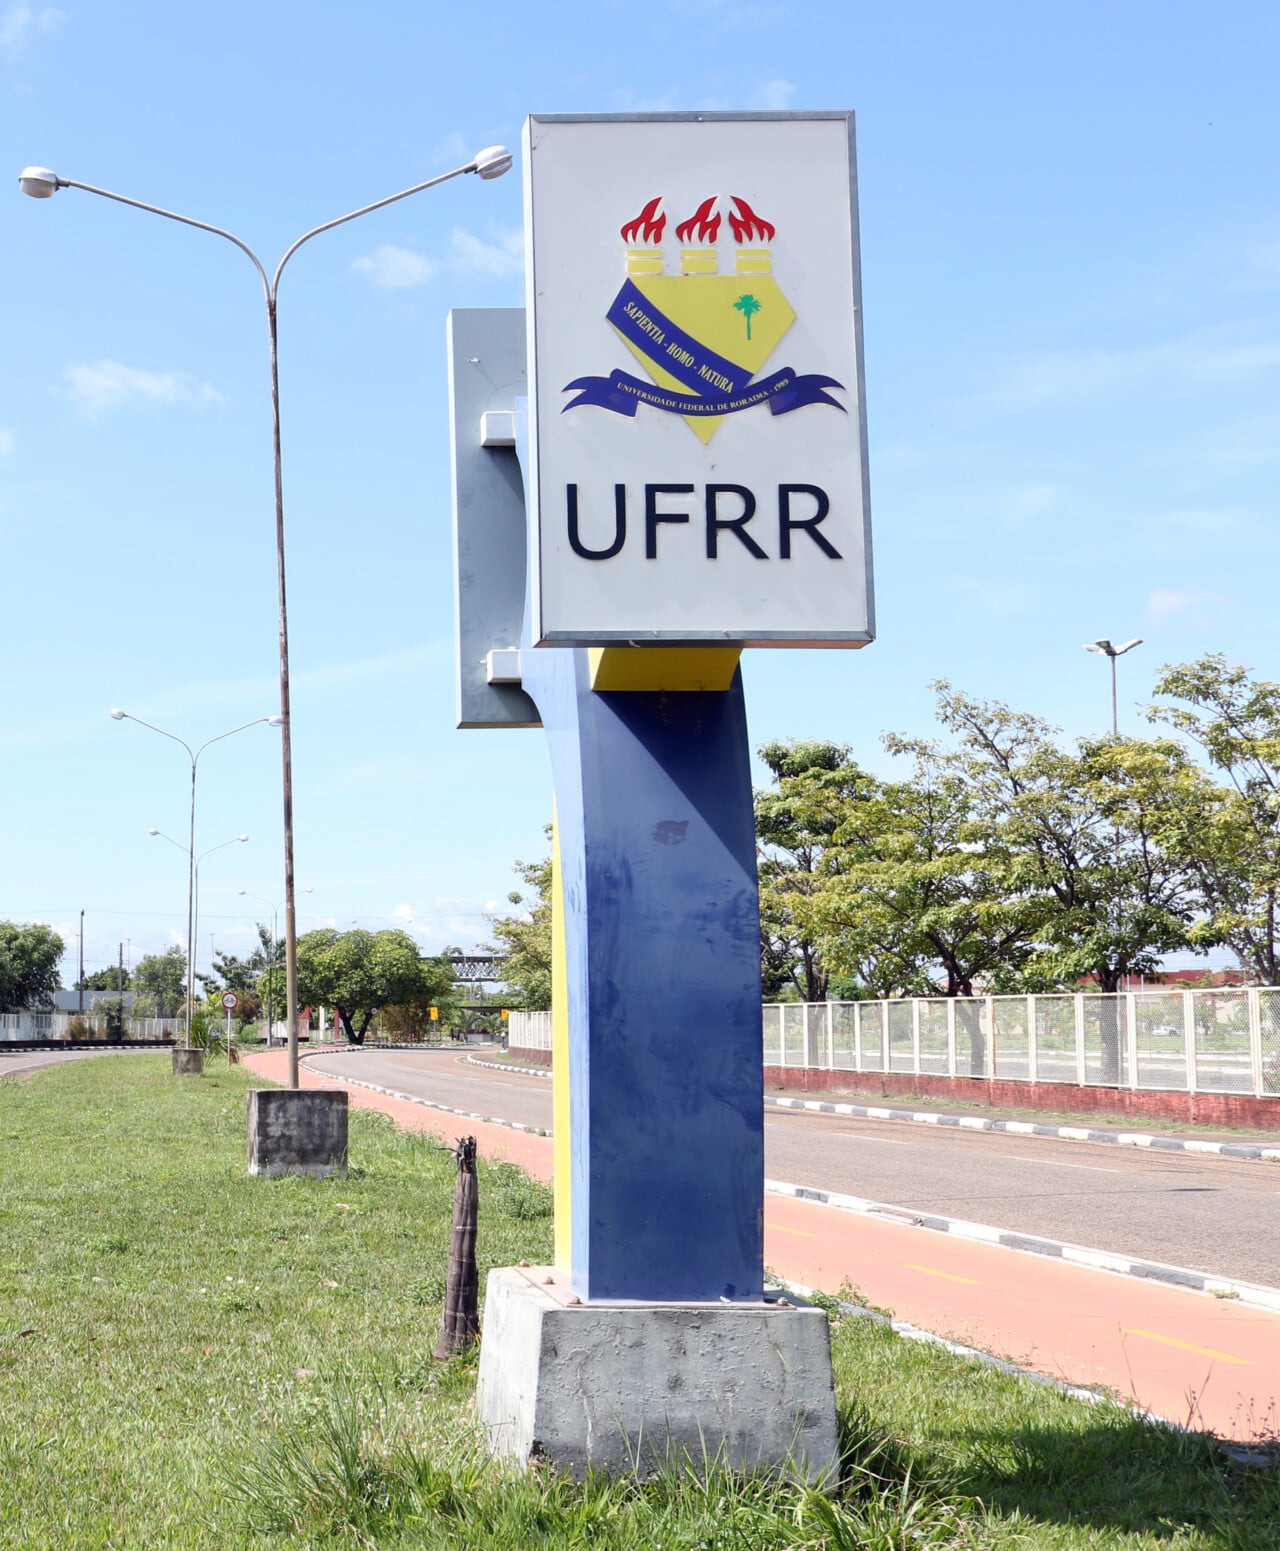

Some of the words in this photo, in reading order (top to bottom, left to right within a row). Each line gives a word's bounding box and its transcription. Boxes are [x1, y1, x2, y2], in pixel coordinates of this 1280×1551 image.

[623, 301, 666, 345] SAPIENTIA
[666, 342, 695, 368] HOMO
[697, 364, 734, 394] NATURA
[617, 382, 676, 408] UNIVERSIDADE
[678, 402, 715, 412] FEDERAL
[717, 402, 728, 411] DE
[730, 390, 769, 409] RORAIMA
[773, 378, 789, 392] 1989
[566, 483, 844, 561] UFRR
